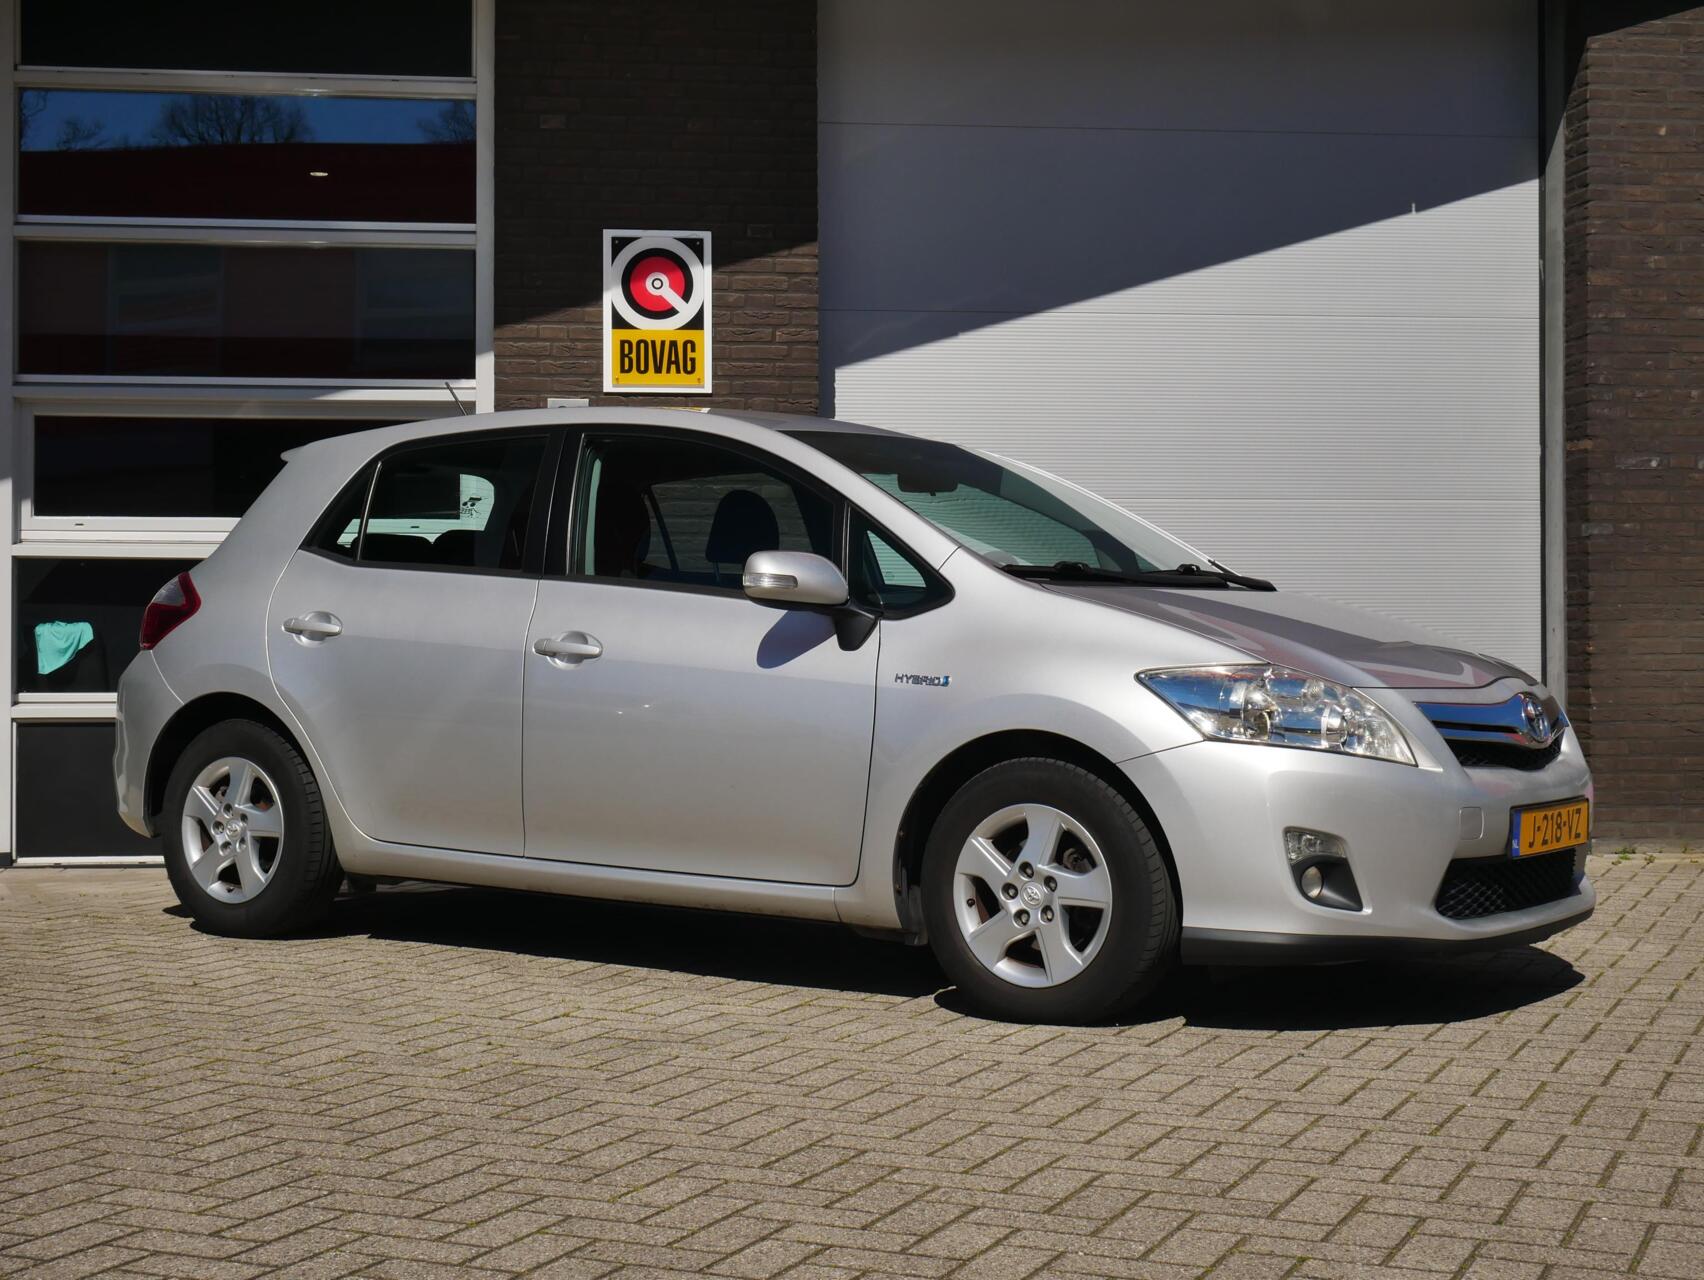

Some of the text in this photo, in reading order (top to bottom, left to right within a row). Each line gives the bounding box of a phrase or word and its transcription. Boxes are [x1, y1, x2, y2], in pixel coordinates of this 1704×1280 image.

[619, 339, 696, 375] BOVAG
[895, 673, 941, 687] HYBRID
[1528, 807, 1582, 848] J-218-VZ
